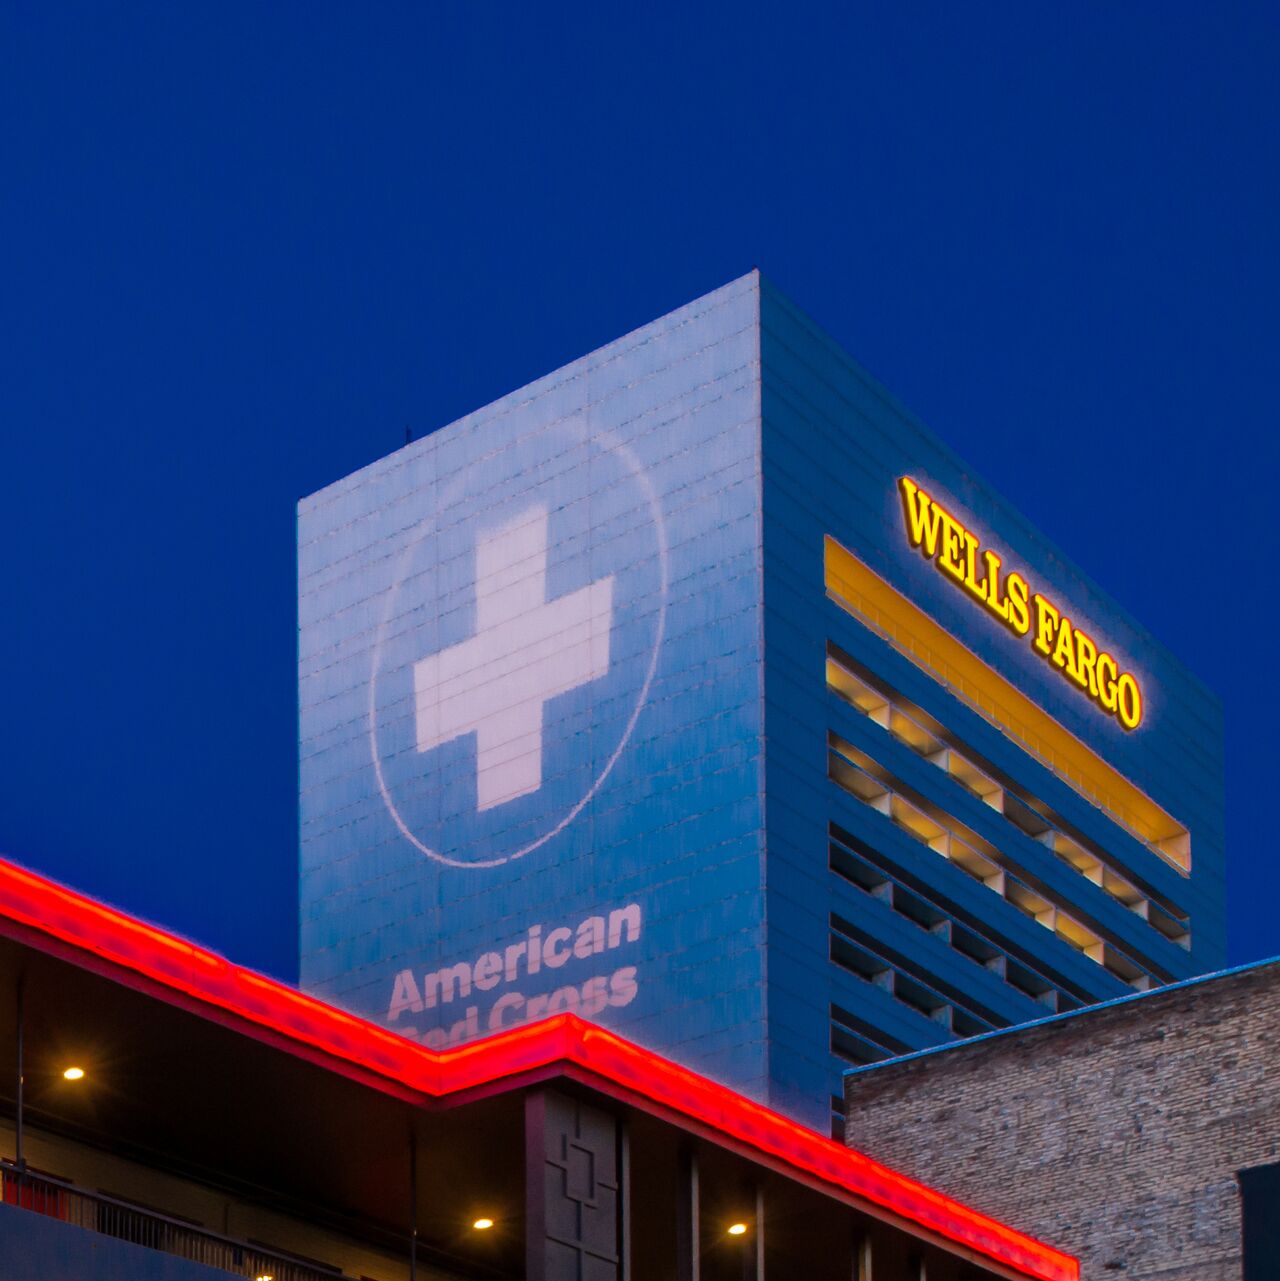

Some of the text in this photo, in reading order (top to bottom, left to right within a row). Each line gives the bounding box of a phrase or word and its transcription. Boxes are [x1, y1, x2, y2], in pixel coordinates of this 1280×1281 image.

[897, 475, 1144, 733] WELLS FARGO
[387, 903, 641, 1021] American
